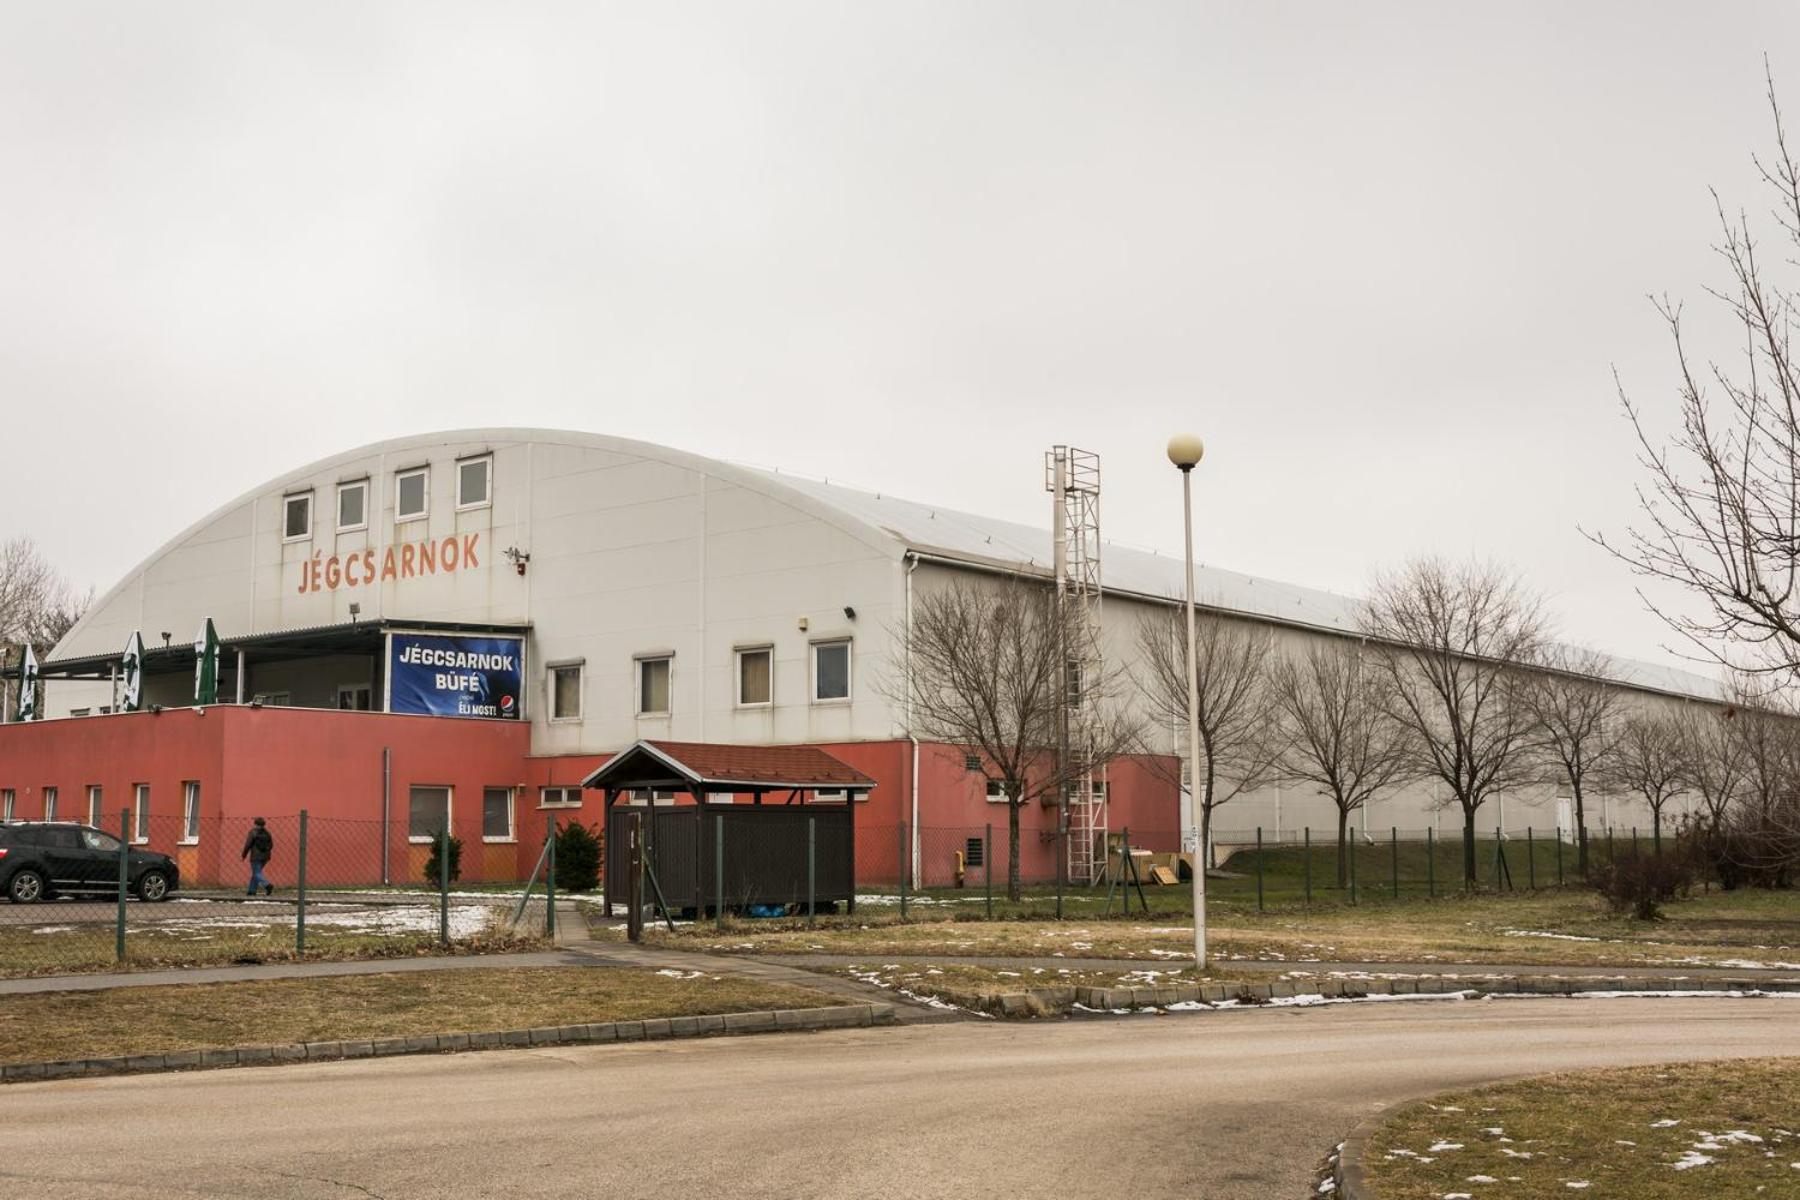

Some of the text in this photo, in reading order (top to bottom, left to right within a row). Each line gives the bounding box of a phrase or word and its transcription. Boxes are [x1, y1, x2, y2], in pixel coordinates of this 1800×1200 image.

[298, 533, 480, 594] JÉGCSARNOK
[399, 643, 513, 671] JÉGCSARNOK
[436, 671, 479, 691] BÜFÉ
